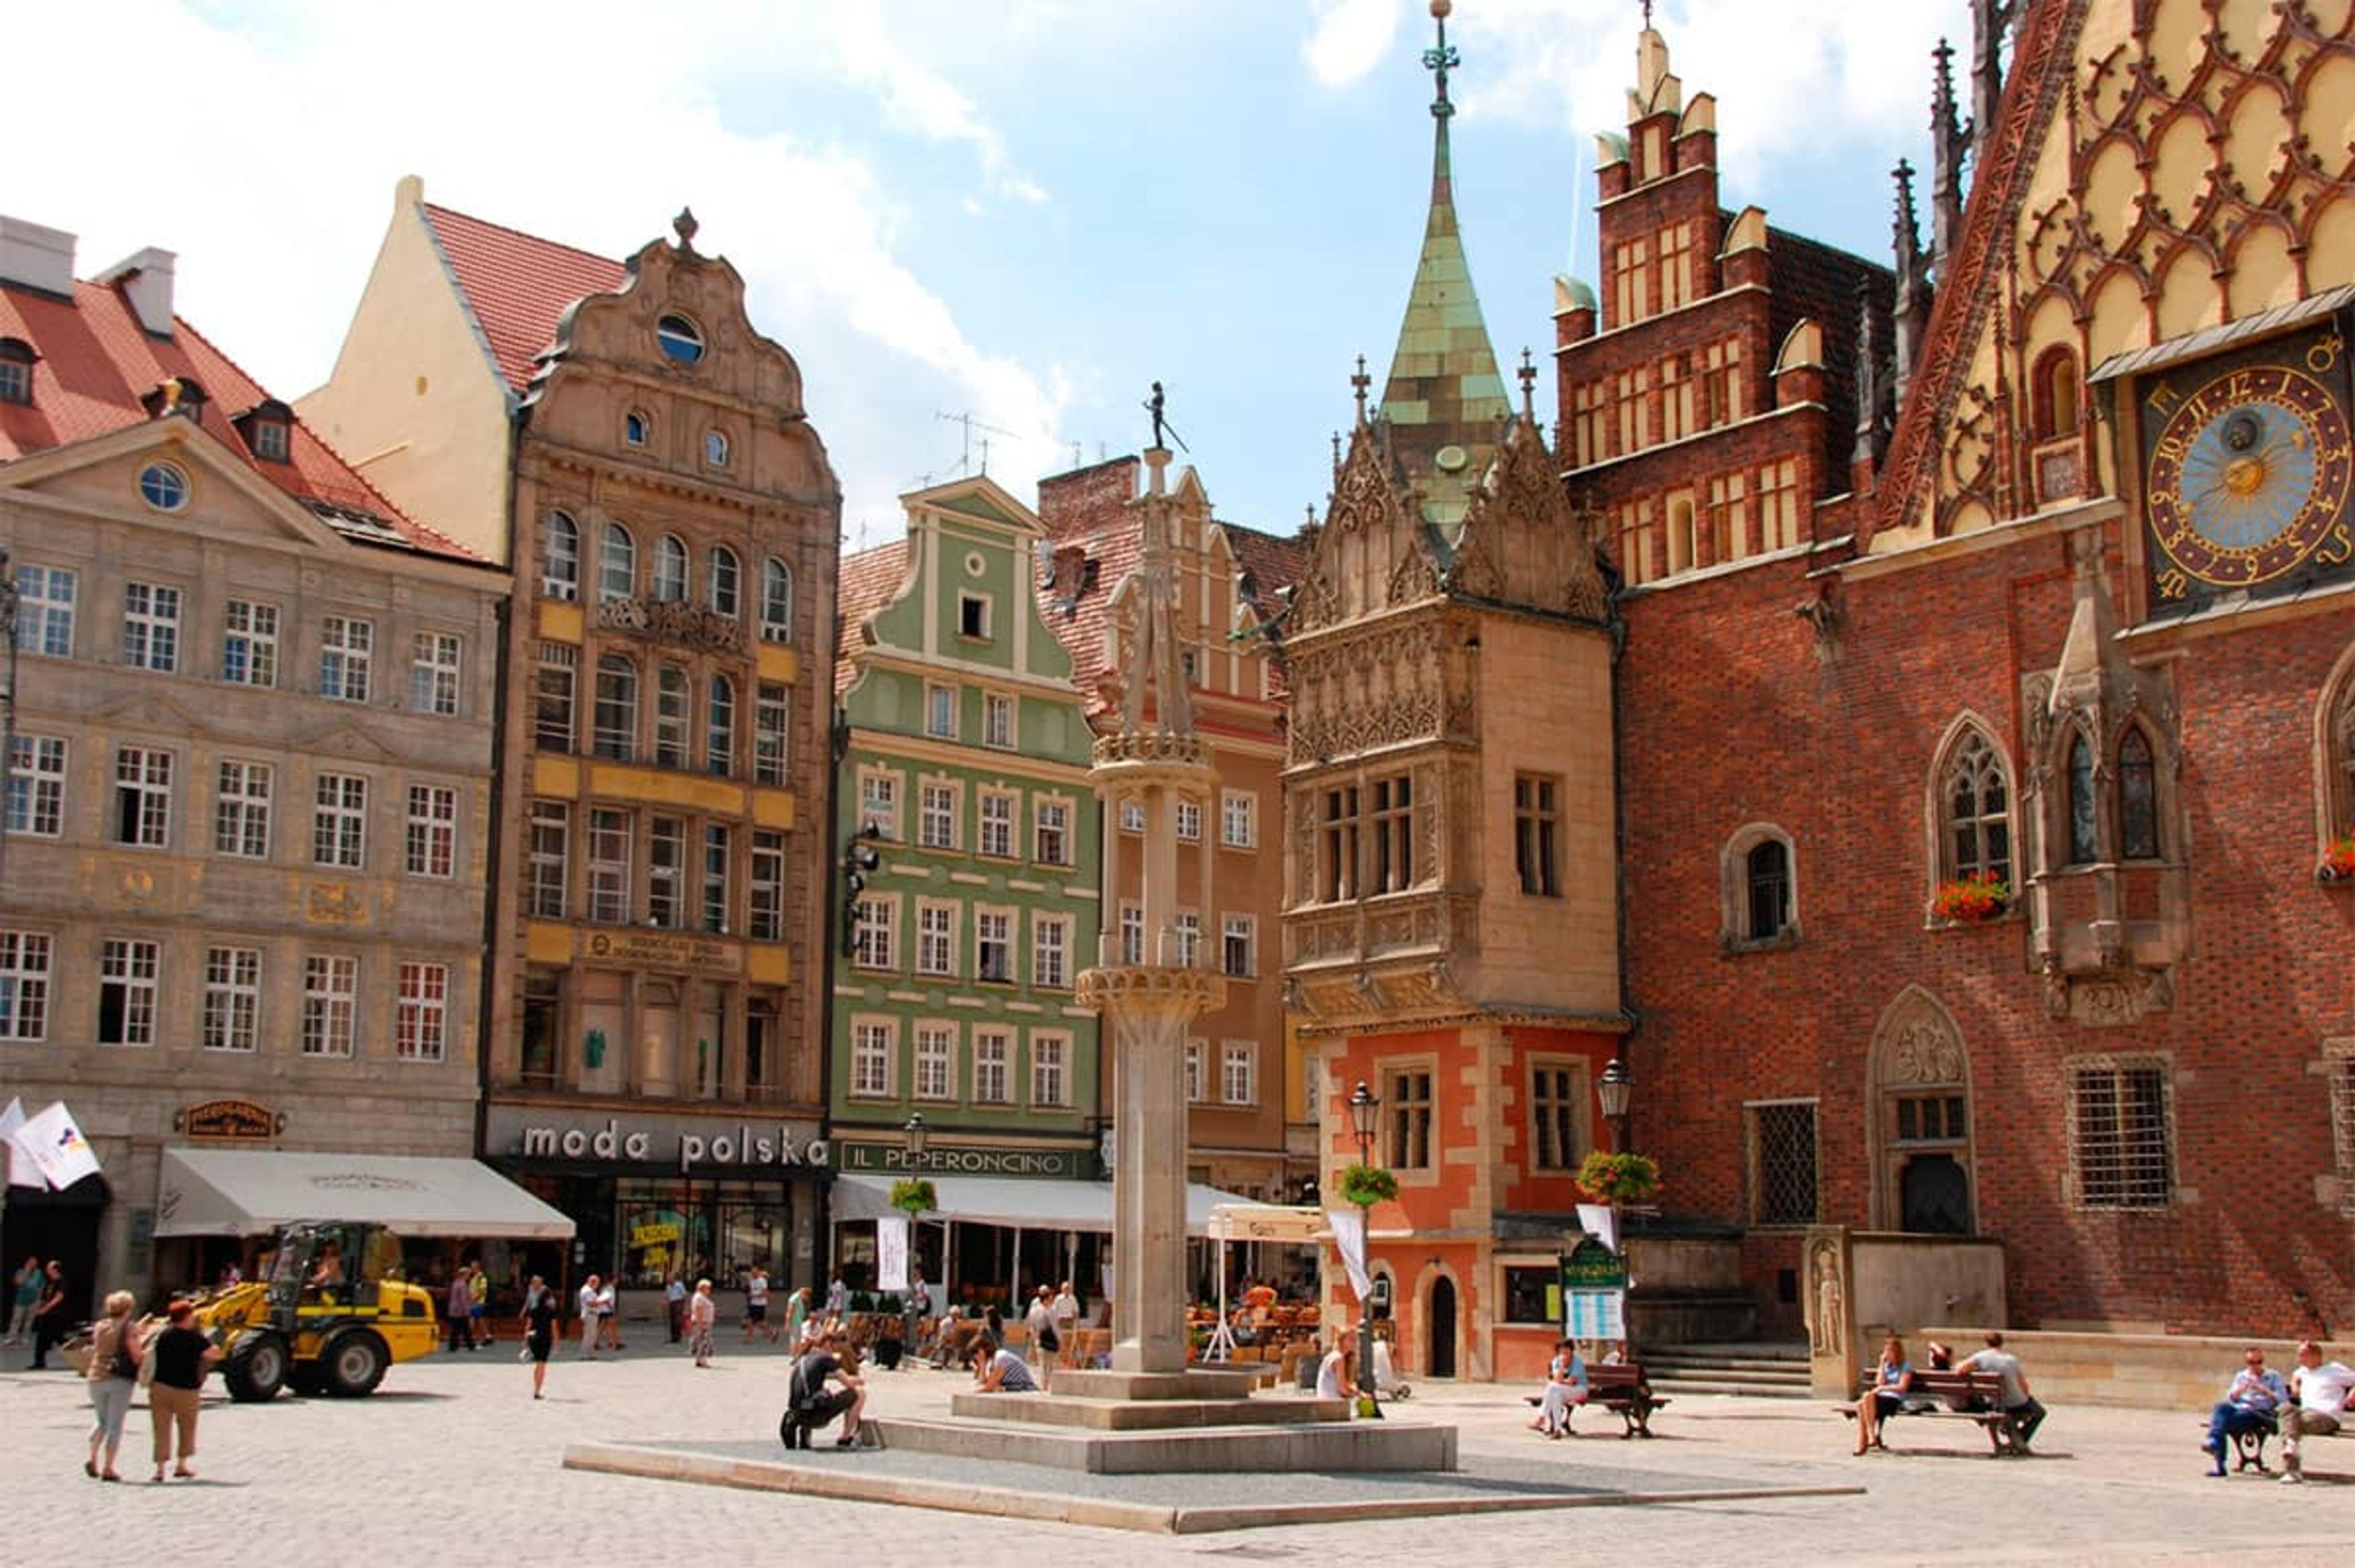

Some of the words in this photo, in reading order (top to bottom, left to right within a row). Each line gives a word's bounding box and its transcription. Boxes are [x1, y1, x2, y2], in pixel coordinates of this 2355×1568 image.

[2230, 373, 2251, 399] 12
[2277, 372, 2292, 396] 1
[2309, 398, 2332, 421] 2
[2159, 437, 2183, 461] 10
[2324, 443, 2350, 462] 3
[2314, 495, 2335, 513] 4
[2166, 530, 2185, 548] 8
[2288, 534, 2306, 557] 5
[2199, 553, 2218, 576] 7
[524, 1119, 650, 1159] moda
[680, 1125, 829, 1172] polska
[854, 1147, 872, 1166] IL
[886, 1149, 1063, 1172] PEPERONCINO
